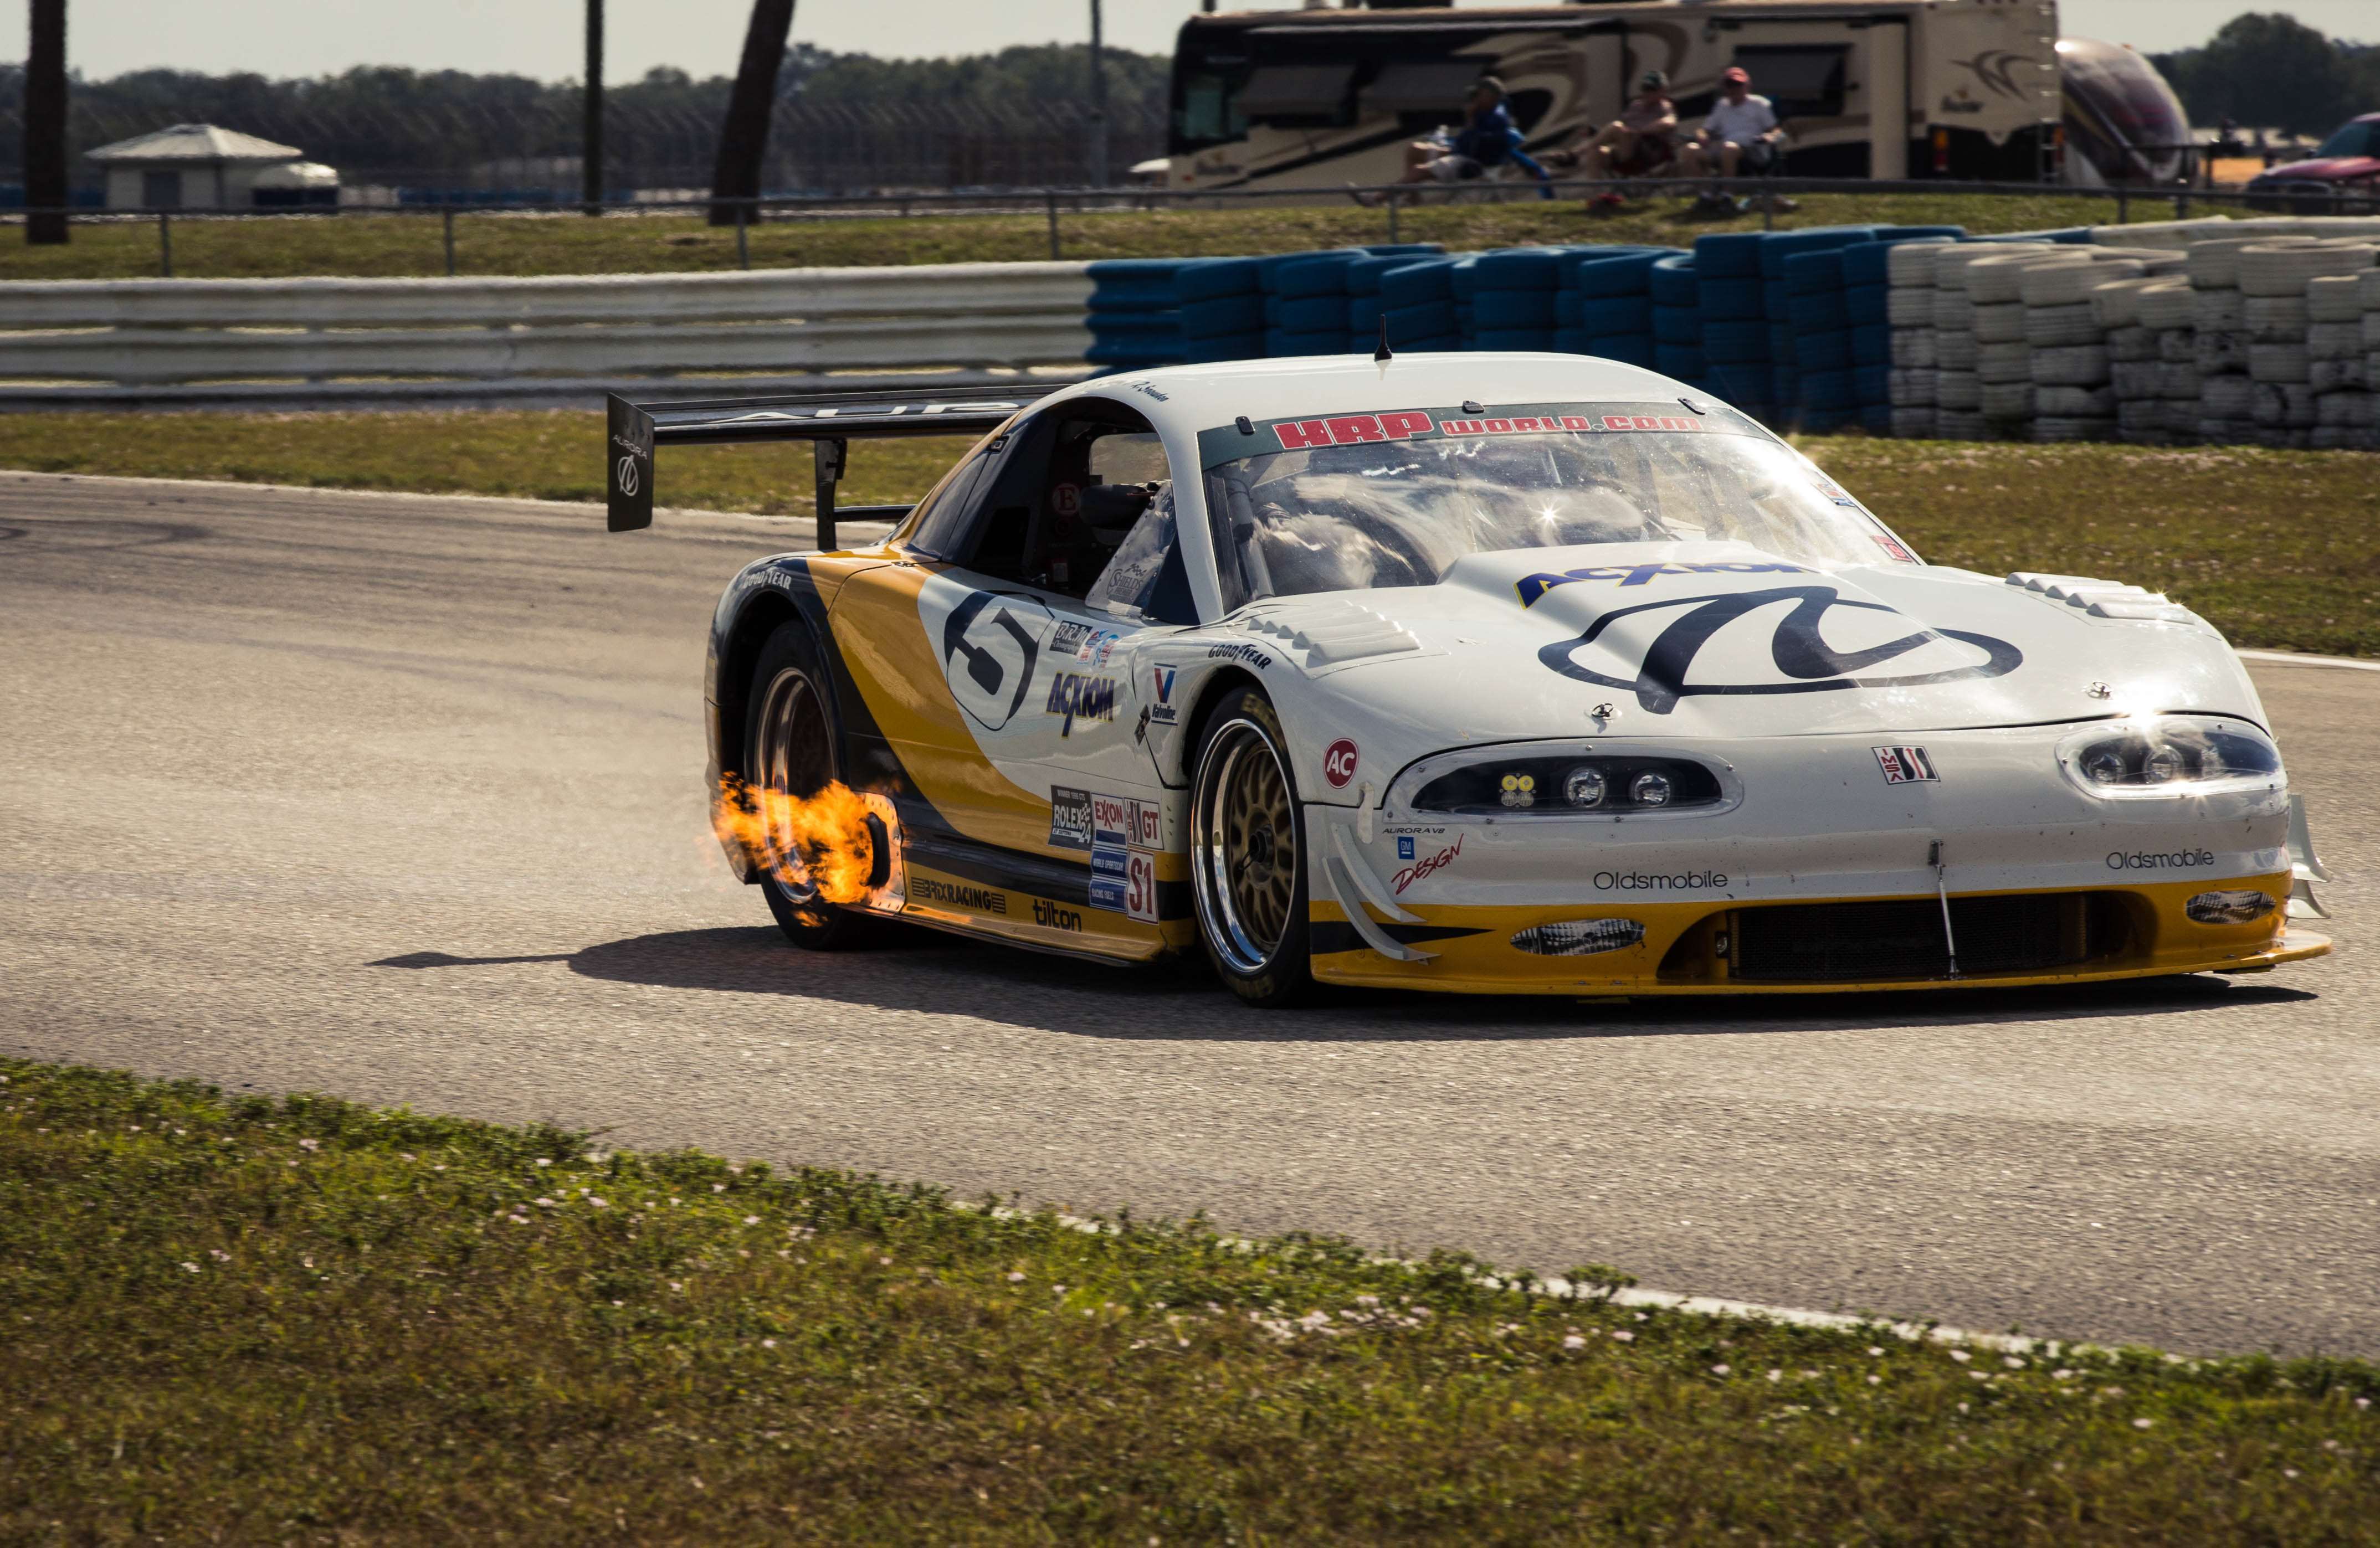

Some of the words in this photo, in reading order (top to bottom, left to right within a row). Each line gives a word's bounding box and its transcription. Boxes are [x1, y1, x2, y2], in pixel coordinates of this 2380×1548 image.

[1272, 412, 1434, 449] HRP
[612, 434, 647, 460] AURORA
[743, 567, 792, 589] GOODYEAR
[1109, 571, 1143, 590] SHIELDS
[1208, 644, 1272, 670] GOODYEAR
[1152, 703, 1176, 721] Valvoline
[1327, 750, 1355, 776] AC
[1880, 748, 1904, 781] IMSA
[1056, 789, 1070, 798] WINNER
[1054, 804, 1082, 830] ROLEX
[1094, 800, 1124, 830] EXXON
[1142, 810, 1158, 840] GT
[1079, 822, 1091, 844] 24
[1400, 841, 1412, 851] GM
[1093, 858, 1104, 868] WORLD
[1105, 860, 1124, 871] SPORTSCAR
[1391, 832, 1464, 896] DESIGN
[2106, 848, 2214, 870] Oldsmobile
[1129, 857, 1153, 914] S1
[1593, 871, 1728, 890] Oldsmobile
[1091, 888, 1104, 899] RACING
[1104, 891, 1114, 901] FUELS
[1033, 899, 1082, 932] tilton
